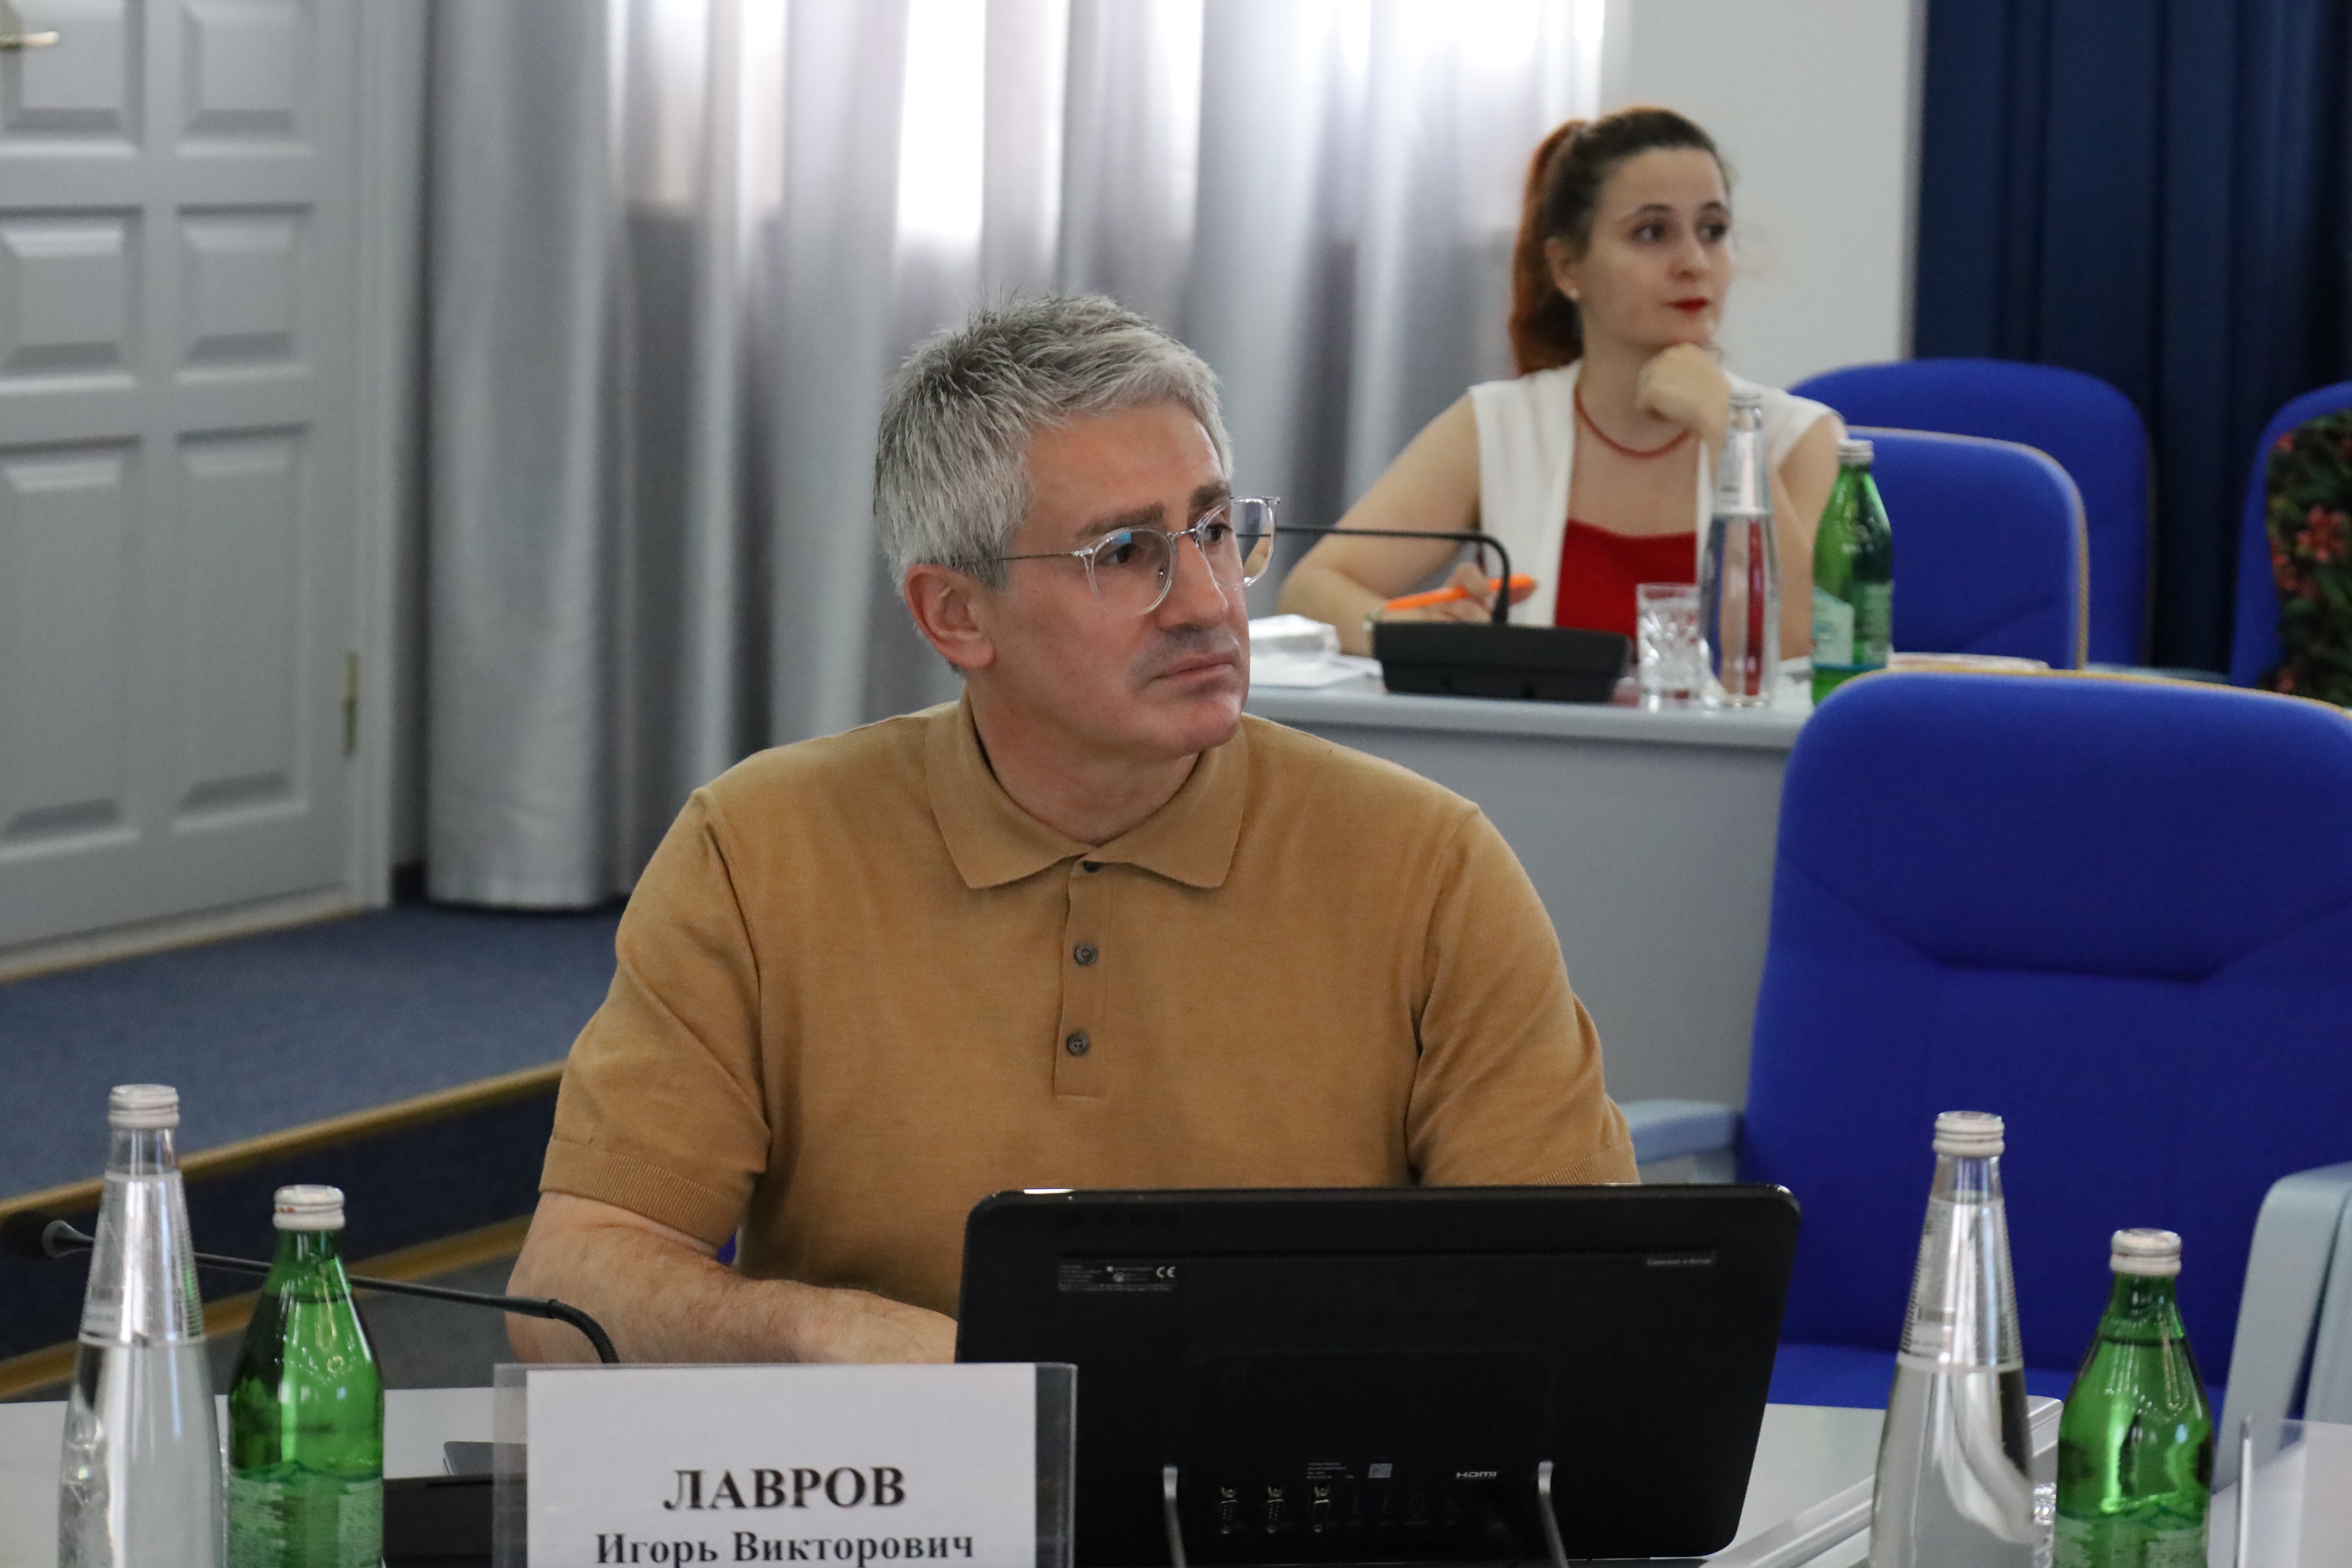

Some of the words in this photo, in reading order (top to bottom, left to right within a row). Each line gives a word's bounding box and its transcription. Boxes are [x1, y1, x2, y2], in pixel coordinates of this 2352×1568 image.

[663, 1466, 905, 1511] ЛАВРОВ
[595, 1532, 718, 1568] Игорь
[732, 1531, 974, 1568] Викторович
